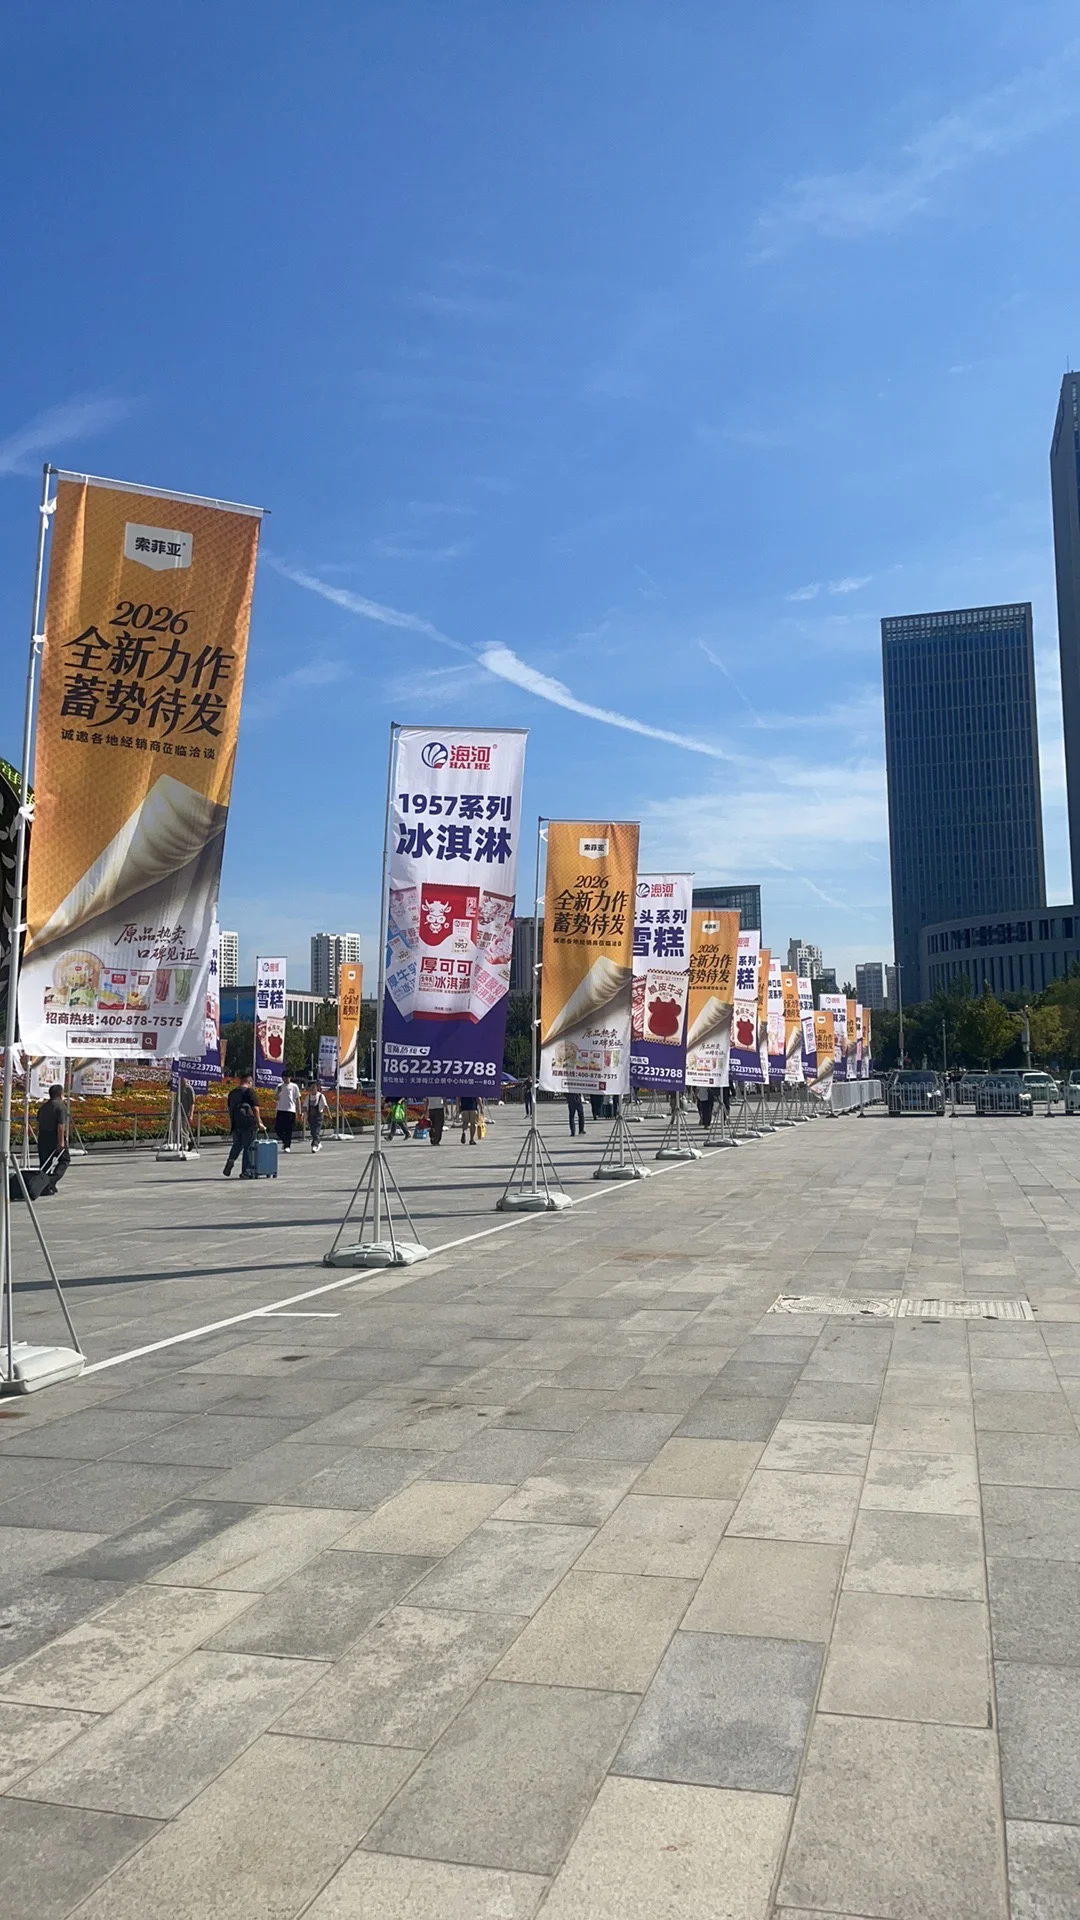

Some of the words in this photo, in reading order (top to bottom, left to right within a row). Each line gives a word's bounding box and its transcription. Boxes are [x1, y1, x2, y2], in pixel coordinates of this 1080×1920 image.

[136, 536, 182, 557] 索菲亚
[109, 601, 195, 634] 2026
[61, 626, 235, 690] 全新力作
[60, 673, 227, 738] 蓄势待发
[61, 728, 215, 760] 诚邀各地经销商莅临洽谈
[450, 744, 491, 762] 海河
[398, 793, 512, 821] 1957系列
[396, 823, 512, 864] 冰淇淋
[574, 875, 612, 889] 2026
[651, 883, 674, 893] 海河
[553, 889, 629, 913] 全新力作
[553, 911, 626, 939] 蓄势待发
[634, 909, 687, 924] 头系列
[114, 923, 186, 946] 原品热卖
[633, 926, 685, 957] 雪糕
[138, 945, 199, 967] 口碑见证
[420, 956, 473, 976] 厚可可
[689, 953, 733, 969] 全新力作
[738, 955, 757, 966] 系列
[435, 976, 471, 990] 冰淇淋
[258, 990, 283, 1009] 雪糕
[383, 1059, 496, 1076] 18622373788
